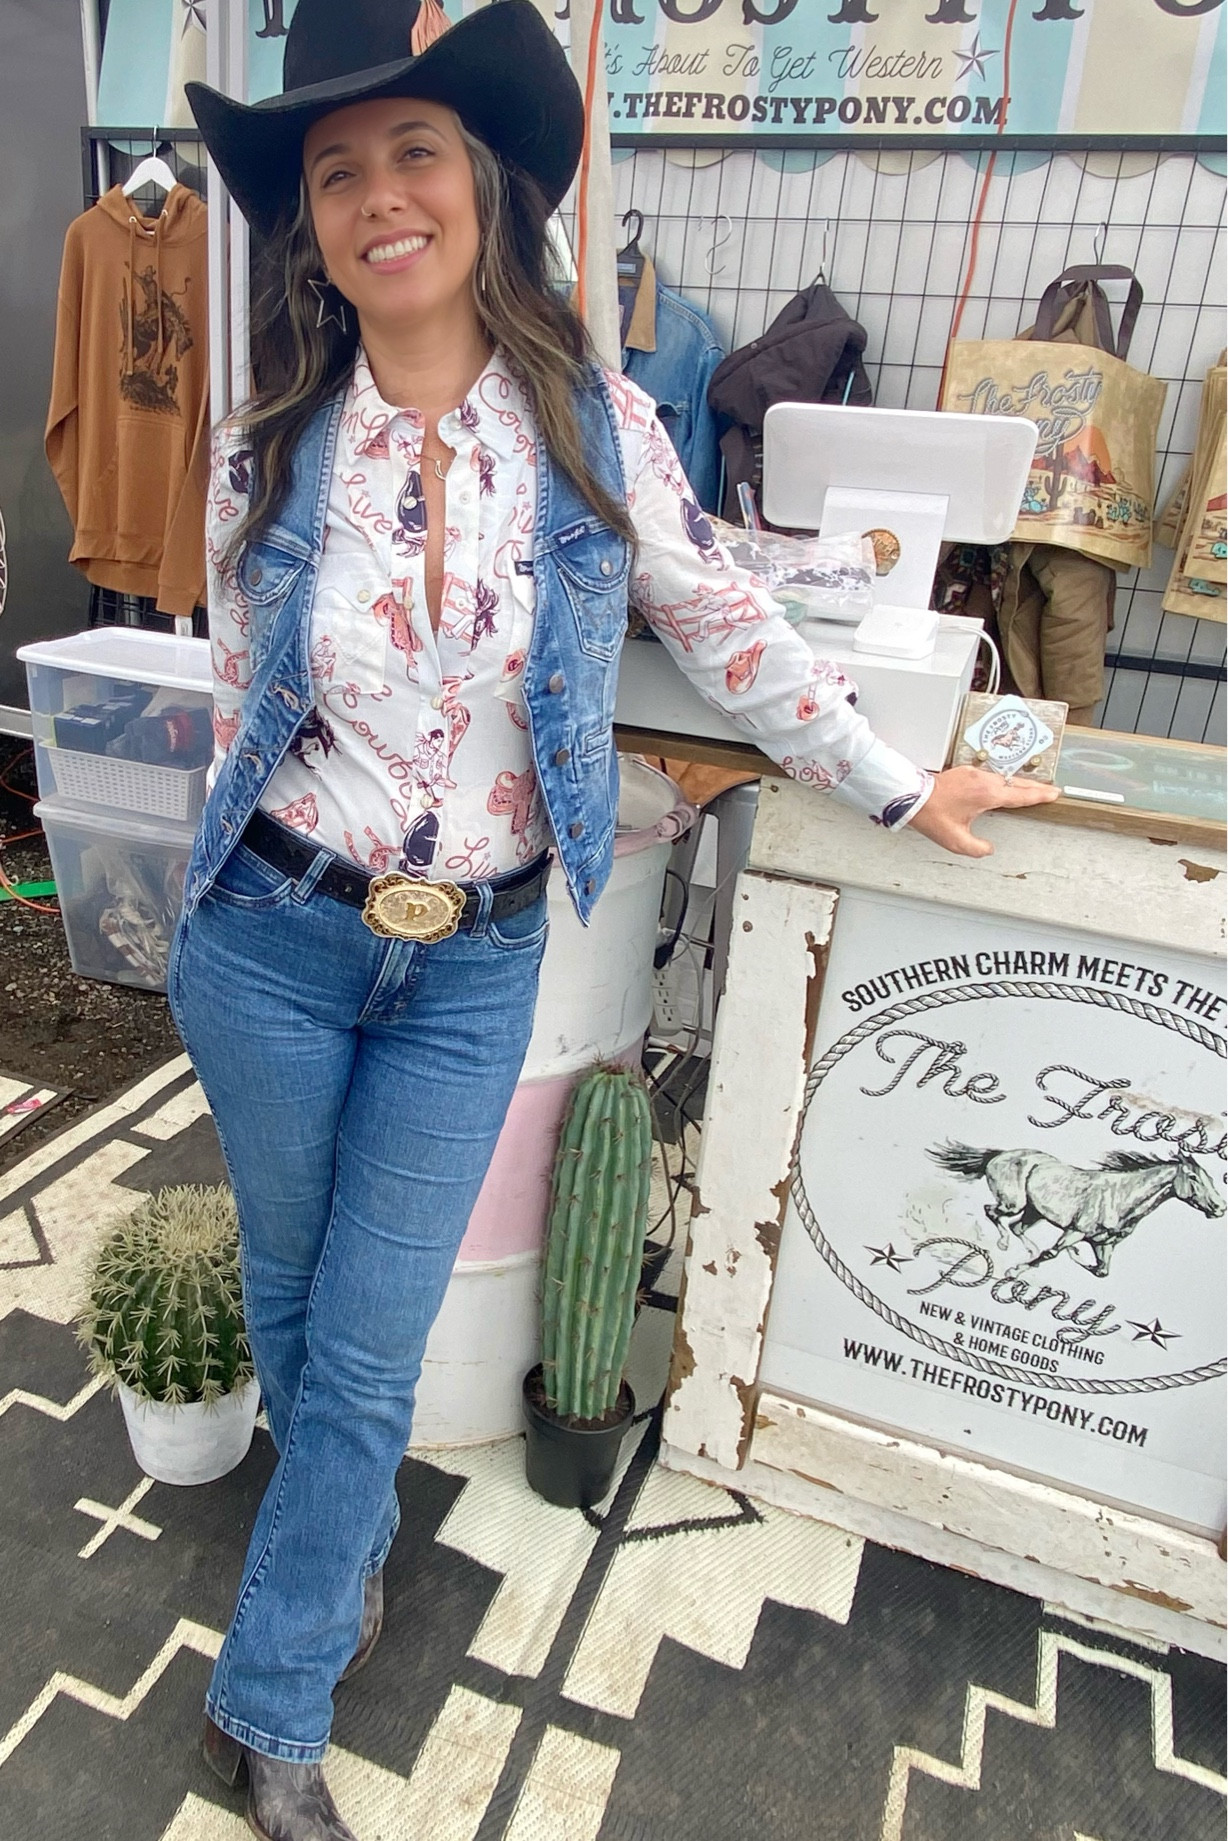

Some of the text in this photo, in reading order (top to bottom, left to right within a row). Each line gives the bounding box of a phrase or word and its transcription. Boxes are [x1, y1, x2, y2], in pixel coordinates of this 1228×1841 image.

[632, 44, 710, 76] About
[723, 44, 761, 77] To
[768, 46, 820, 93] Get
[828, 44, 944, 81] Western
[607, 91, 1011, 126] .THEFROSTYPONY.COM
[1012, 366, 1103, 418] Frosty
[841, 950, 1223, 1021] SOUTHERN CHARM MEETS THE
[860, 1029, 1227, 1160] The Fros
[906, 1236, 1122, 1345] Pony
[919, 1300, 1106, 1366] NEW & VINTAGE CLOTHING
[952, 1331, 1060, 1374] & HOME GOODS
[842, 1336, 1150, 1448] WWW.THEFROSTYPONY.COM
